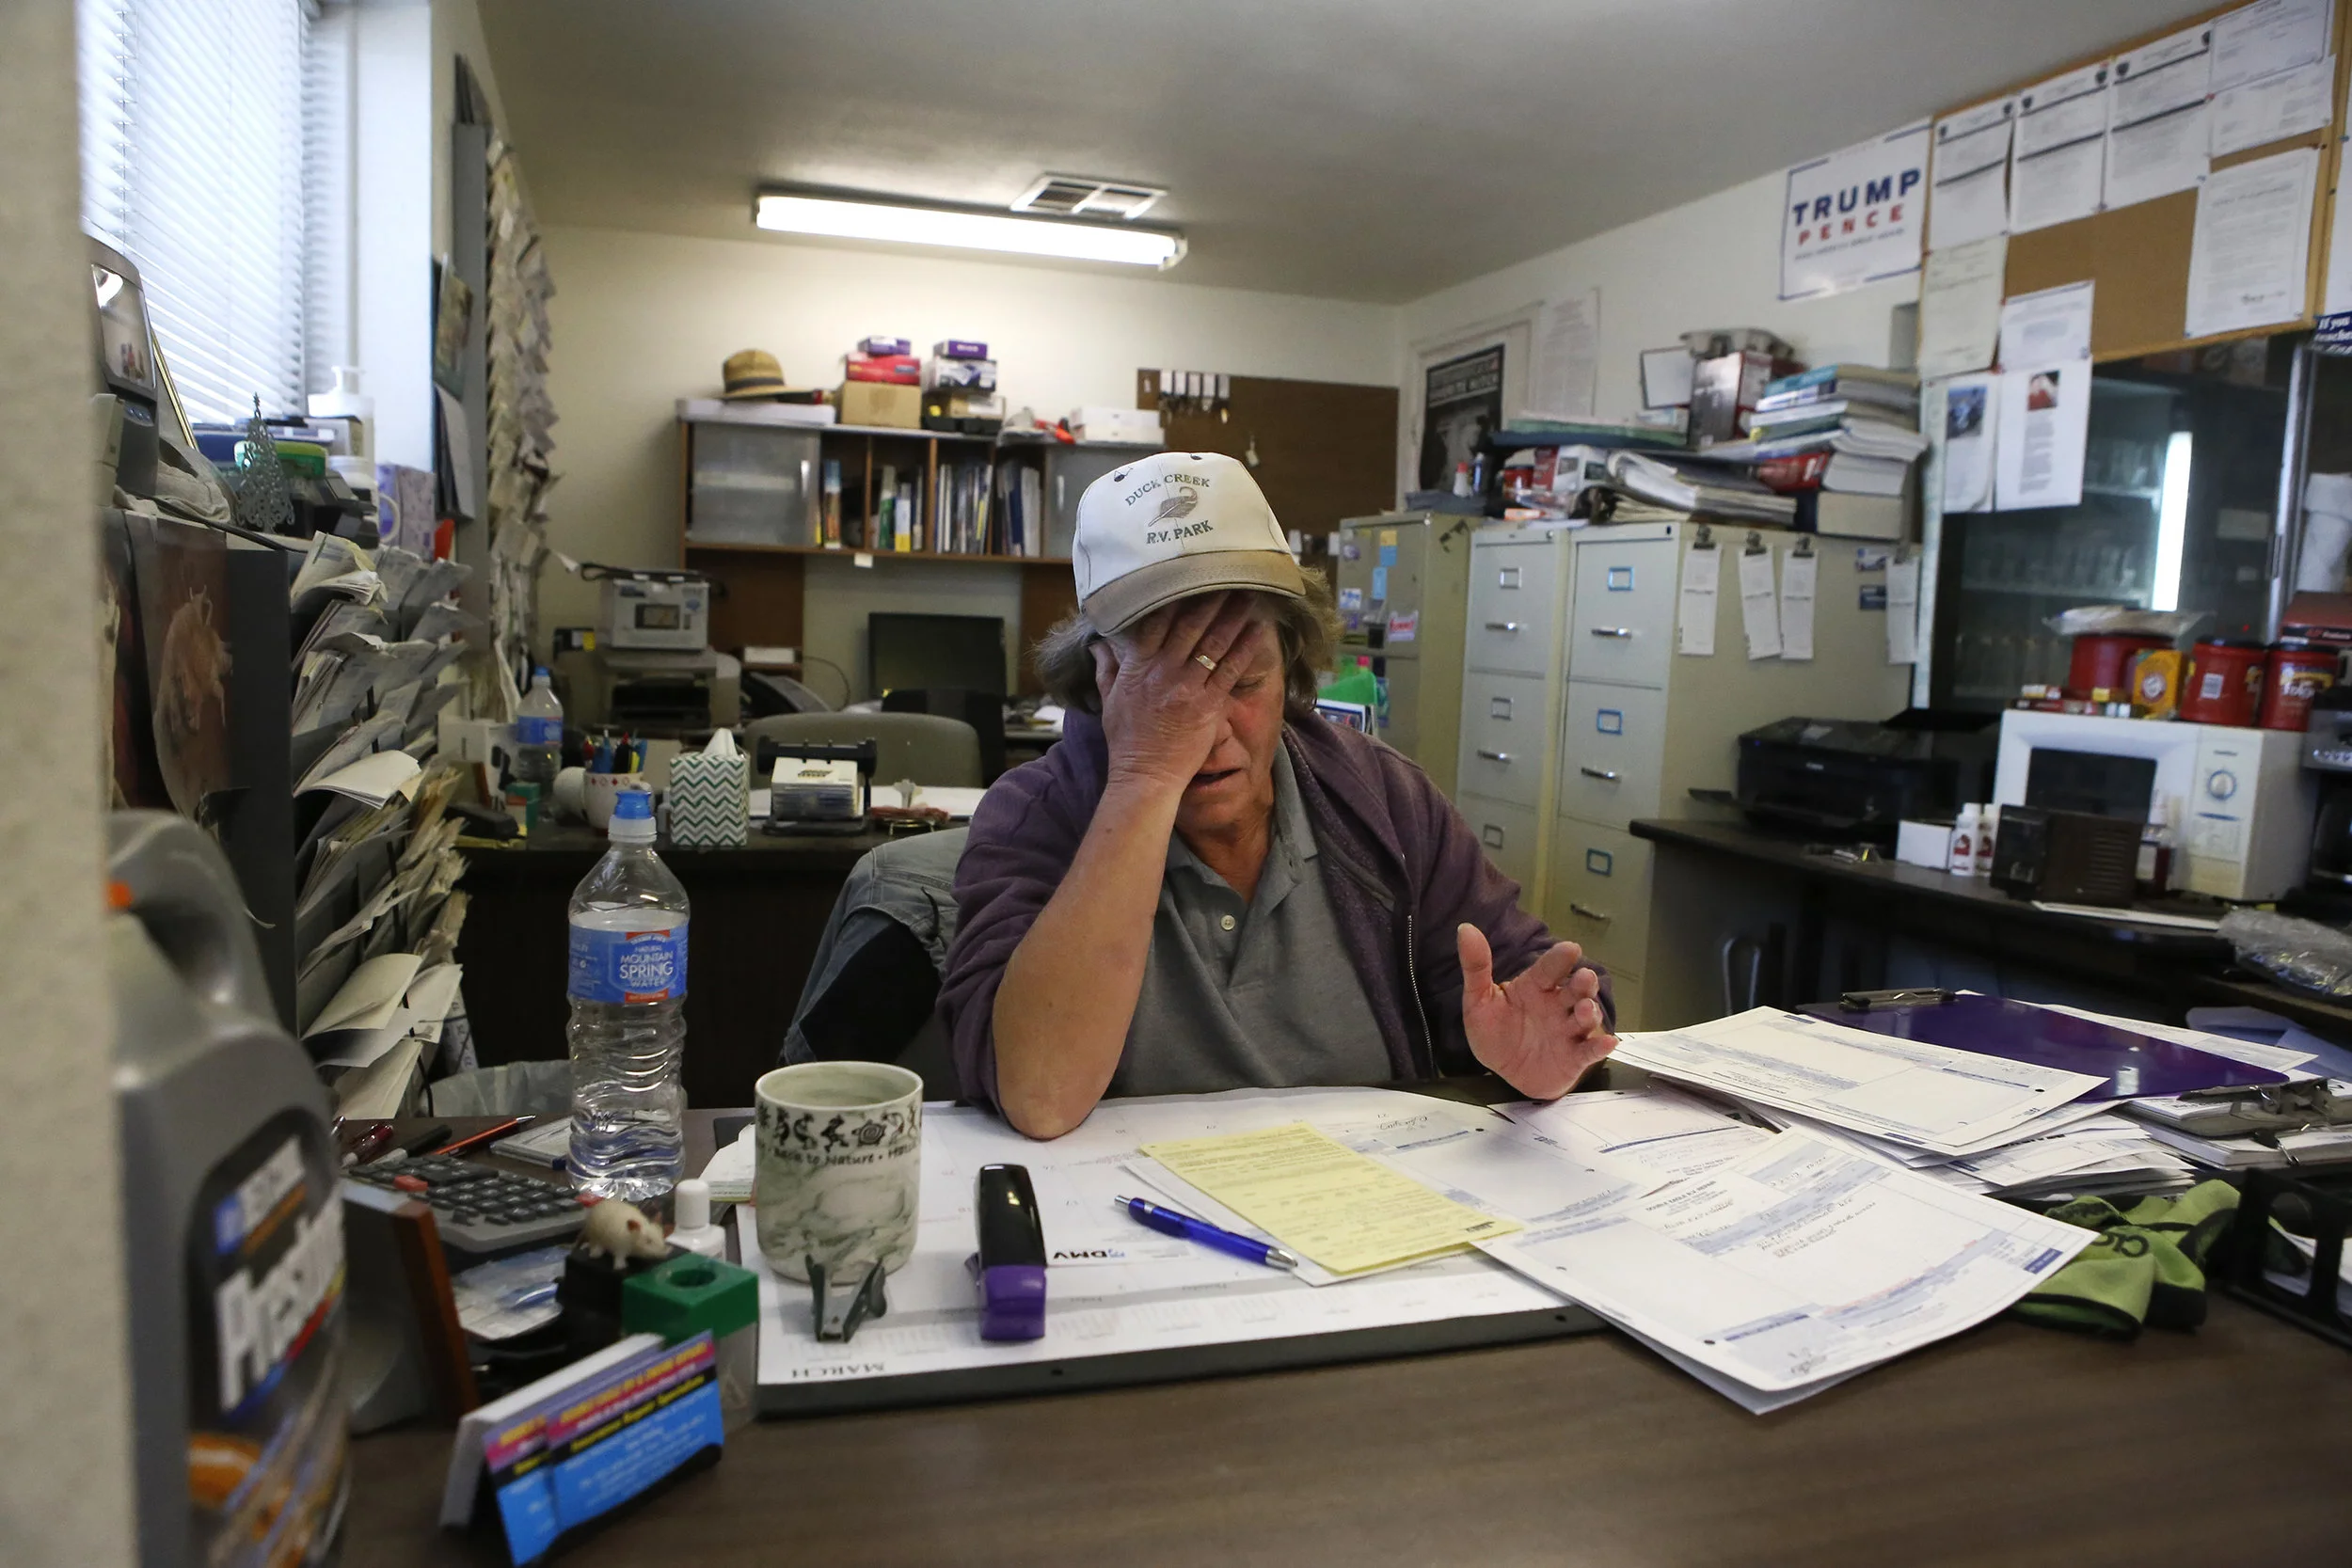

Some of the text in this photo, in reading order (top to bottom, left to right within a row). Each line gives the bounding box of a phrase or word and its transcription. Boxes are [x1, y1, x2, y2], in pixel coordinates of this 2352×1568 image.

[1792, 167, 1921, 227] TRUMP
[1798, 203, 1905, 246] PENCE
[1124, 474, 1211, 506] DUCK CREEK
[1146, 519, 1214, 545] R.V. PARK
[620, 951, 674, 963] MOUNTAIN
[619, 960, 674, 979] SPRING
[630, 978, 667, 988] WATER
[806, 1152, 819, 1165] to
[824, 1151, 874, 1166] Nature
[1053, 1249, 1107, 1260] DMV
[791, 1361, 884, 1379] MARCH
